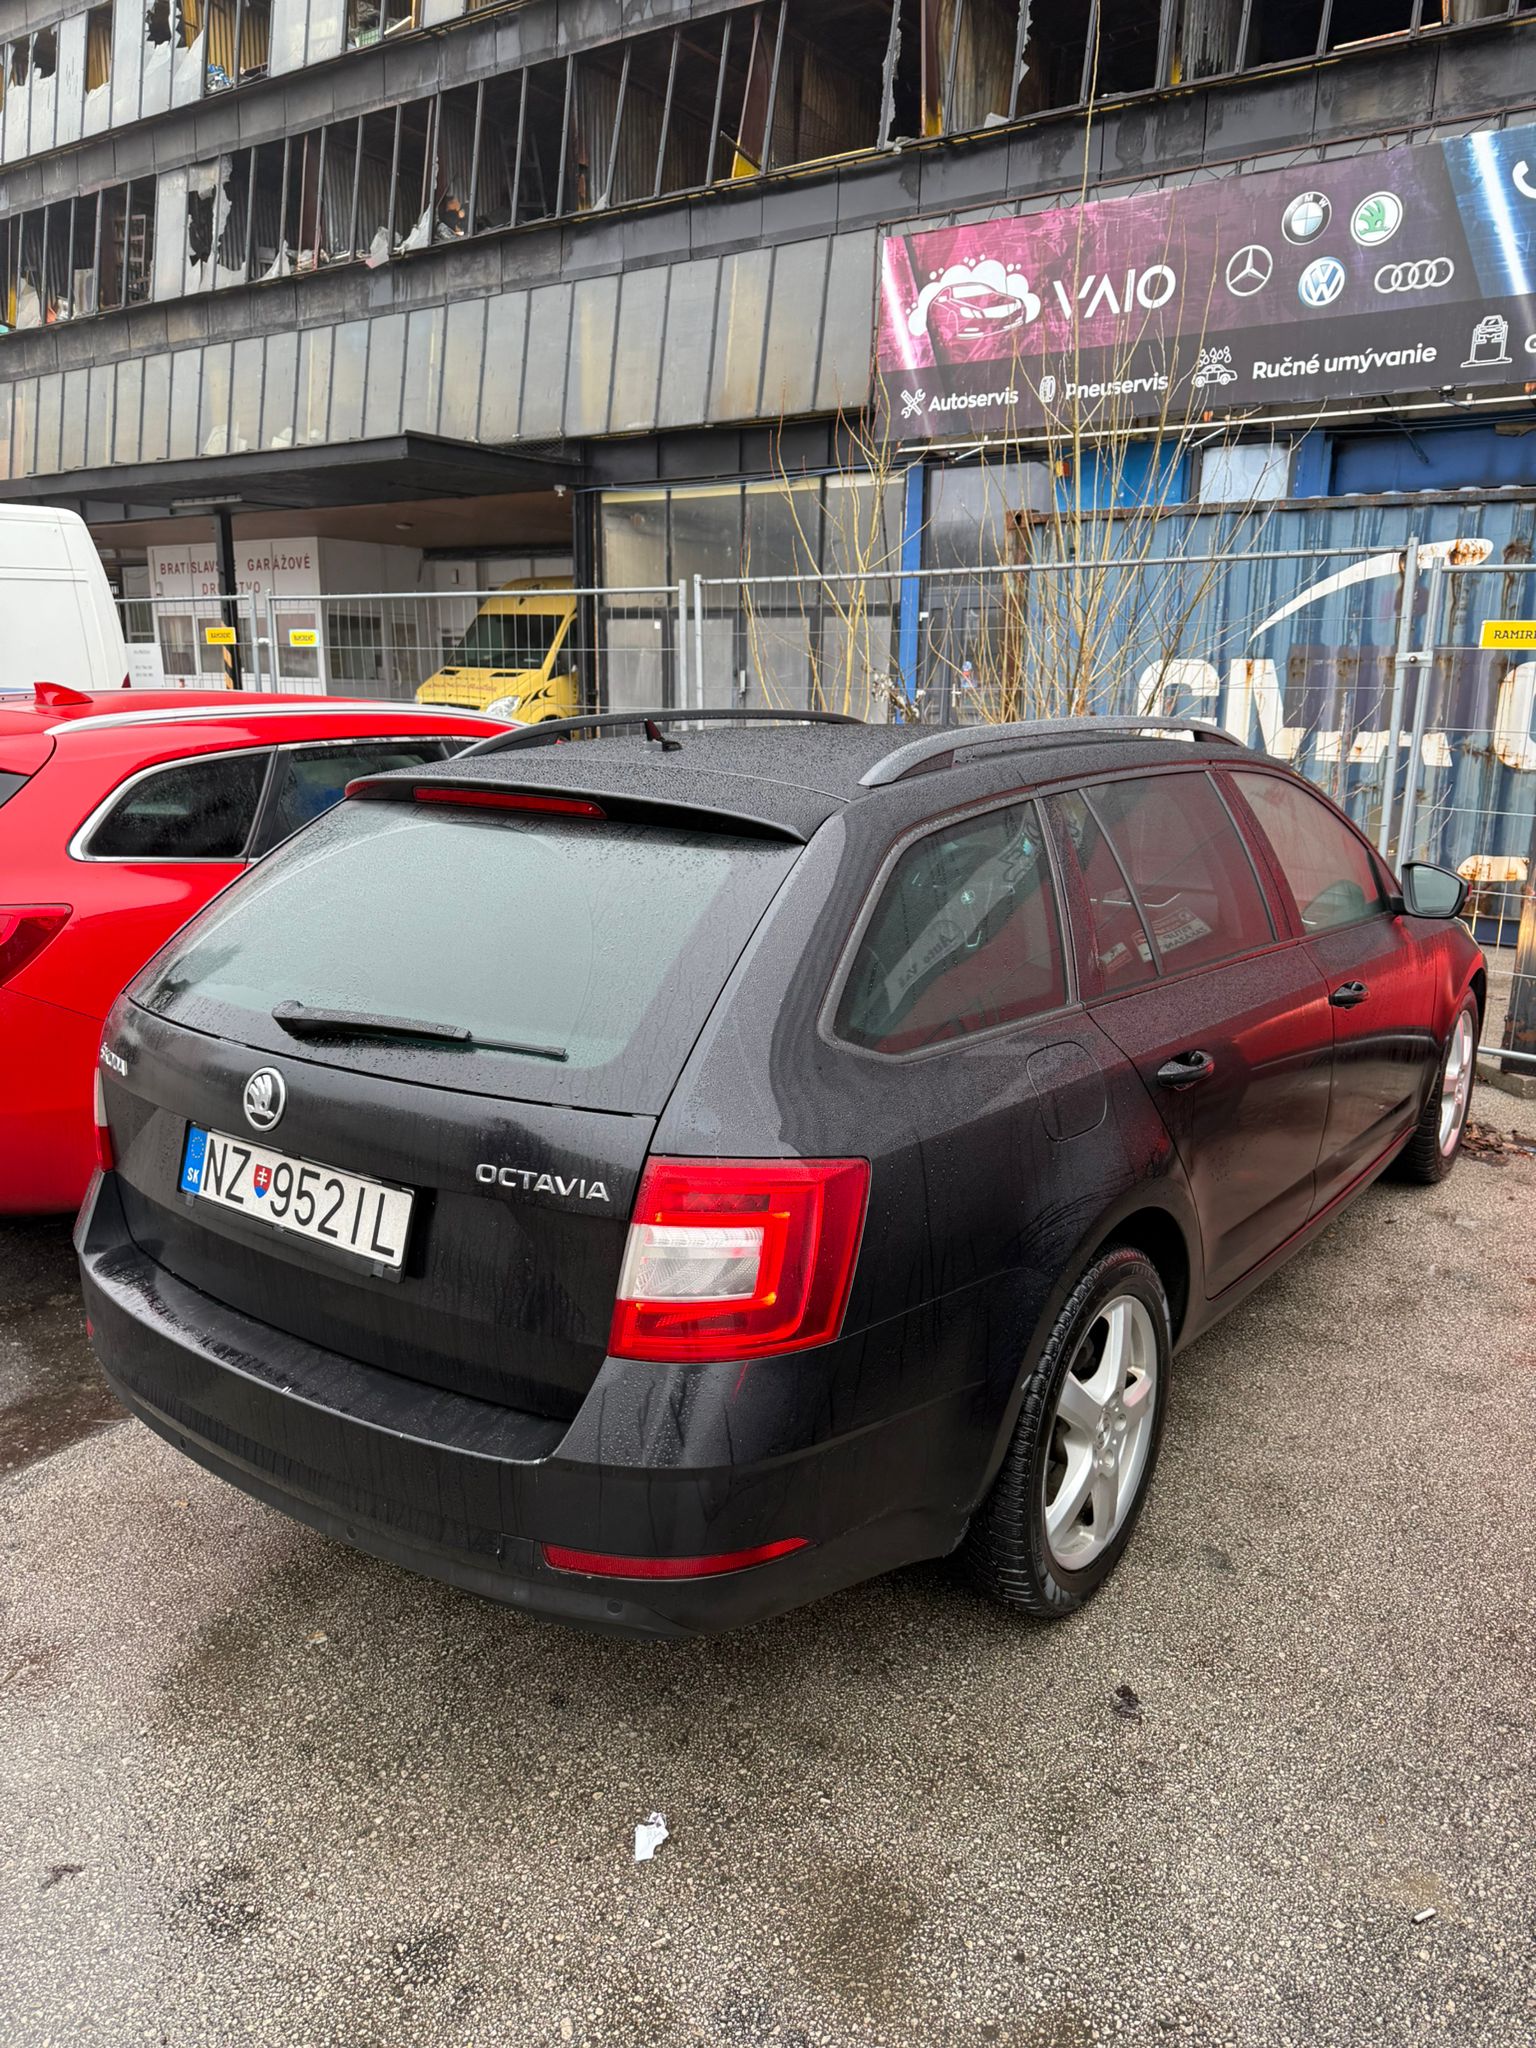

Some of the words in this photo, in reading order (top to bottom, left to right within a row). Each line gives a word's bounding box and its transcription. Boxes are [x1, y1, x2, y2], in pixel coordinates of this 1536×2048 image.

[1053, 264, 1177, 320] VAIO
[1252, 354, 1321, 380] Ručné
[1324, 343, 1438, 374] umývanie
[928, 387, 1019, 412] Autoservis
[1065, 372, 1169, 400] Pneuservis
[247, 553, 311, 572] GARÁŽOVÉ
[187, 1167, 200, 1184] SK
[475, 1163, 610, 1202] OCTAVIA
[203, 1138, 252, 1205] NZ
[269, 1162, 395, 1258] 952IL
